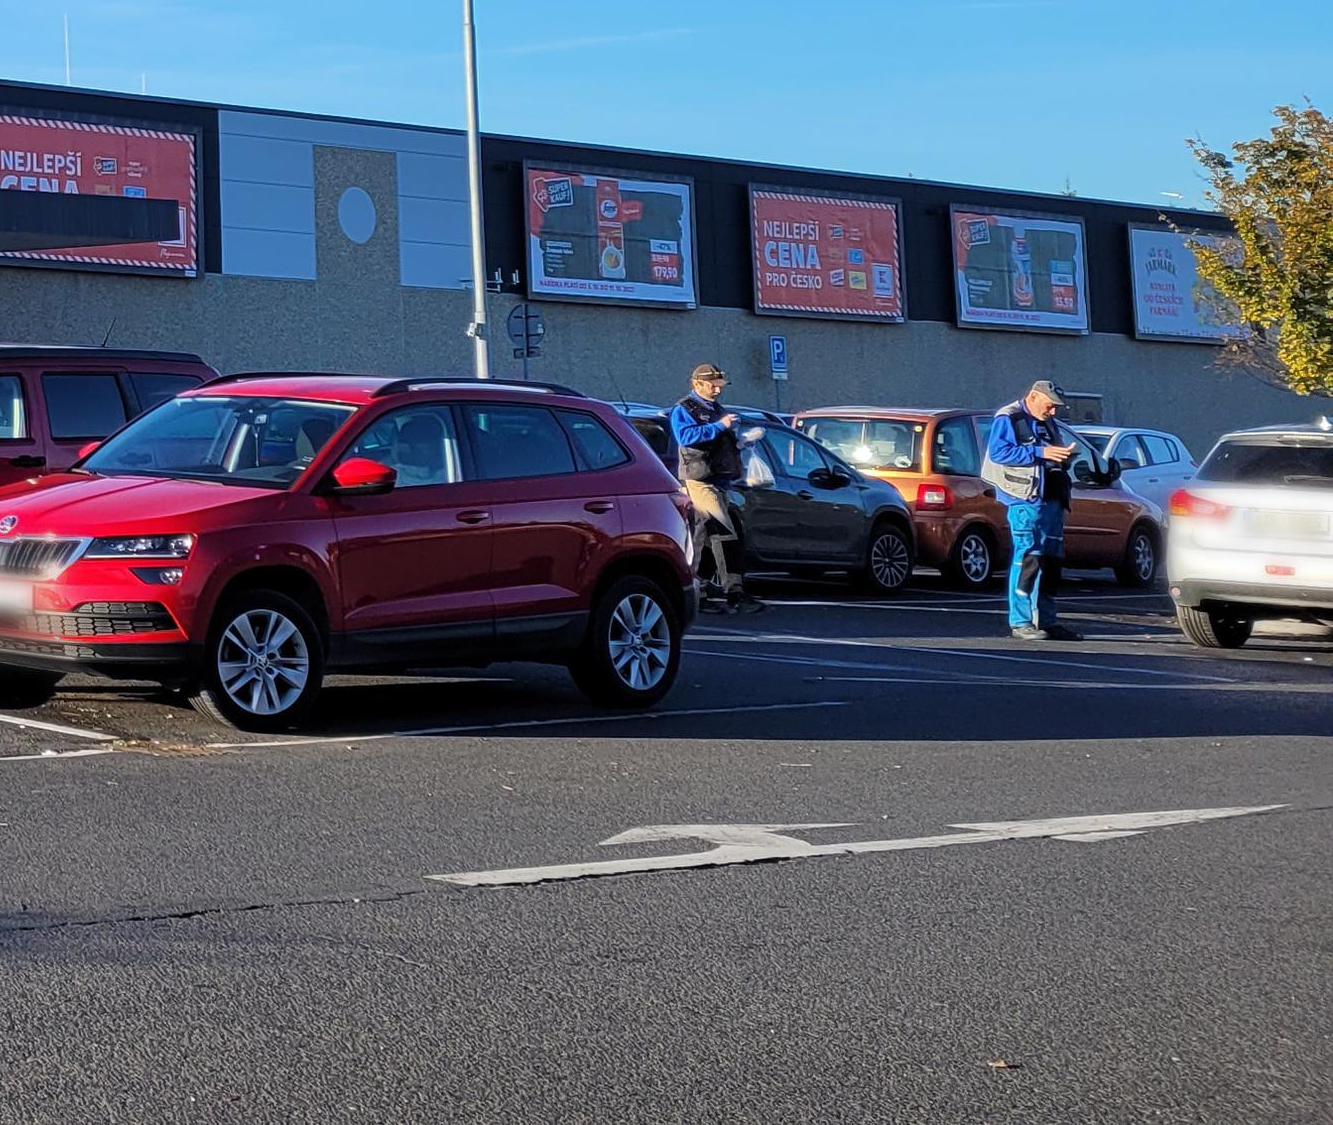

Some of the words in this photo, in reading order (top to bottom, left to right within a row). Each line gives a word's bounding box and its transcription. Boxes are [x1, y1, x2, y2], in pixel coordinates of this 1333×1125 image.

[0, 149, 82, 176] NEJLEPŠÍ
[548, 181, 569, 195] SUPER
[763, 220, 820, 241] NEJLEPŠÍ
[764, 241, 822, 270] CENA
[765, 272, 788, 287] PRO
[790, 271, 823, 290] ČESKO
[773, 340, 783, 360] P
